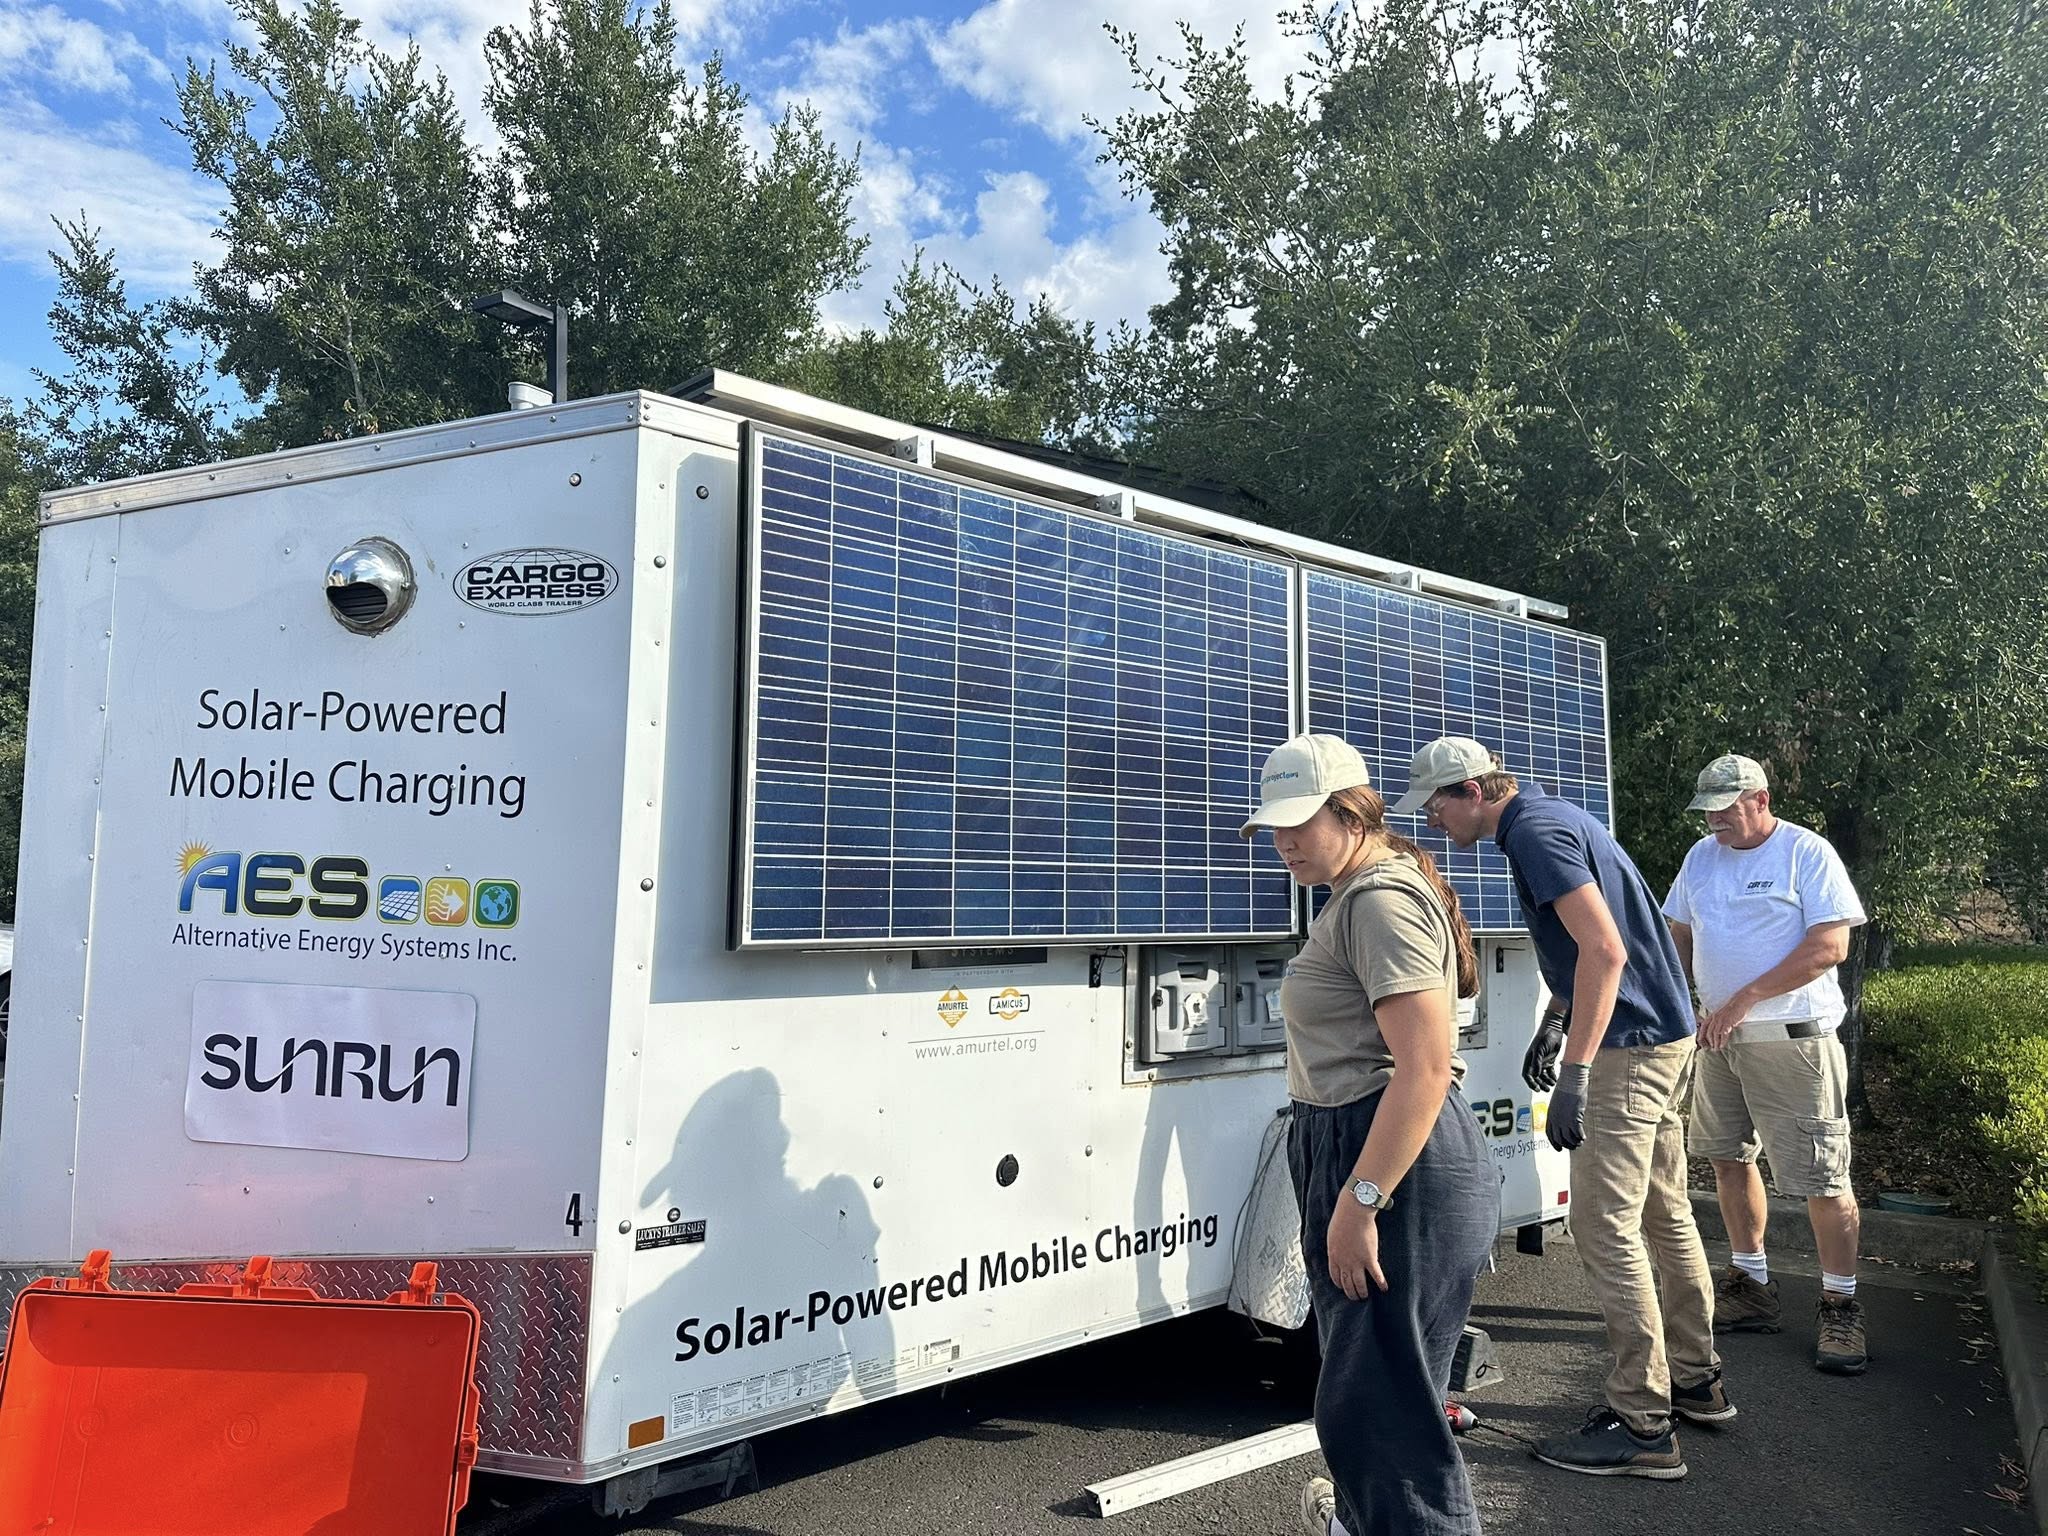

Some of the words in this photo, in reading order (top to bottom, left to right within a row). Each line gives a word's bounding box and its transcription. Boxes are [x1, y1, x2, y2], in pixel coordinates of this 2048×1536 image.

[467, 563, 606, 586] CARGO
[466, 582, 606, 601] EXPRESS
[197, 688, 507, 735] Solar-Powered
[170, 756, 315, 801] Mobile
[328, 759, 526, 819] Charging
[178, 851, 370, 919] AES
[172, 923, 291, 950] Alternative
[298, 929, 375, 960] Energy
[380, 933, 470, 962] Systems
[477, 937, 517, 962] Inc.
[937, 1001, 969, 1012] AMURTEL
[996, 999, 1024, 1010] AMICUS
[915, 1037, 1037, 1060] www.amurtel.org
[1491, 1144, 1516, 1159] nergy
[565, 1193, 583, 1237] 4
[637, 1227, 661, 1241] LUCKY'S
[662, 1224, 687, 1238] TRAILER
[687, 1221, 705, 1234] SALES
[674, 1257, 967, 1362] Solar-Powered
[978, 1236, 1087, 1292] Mobile
[1095, 1212, 1218, 1263] Charging
